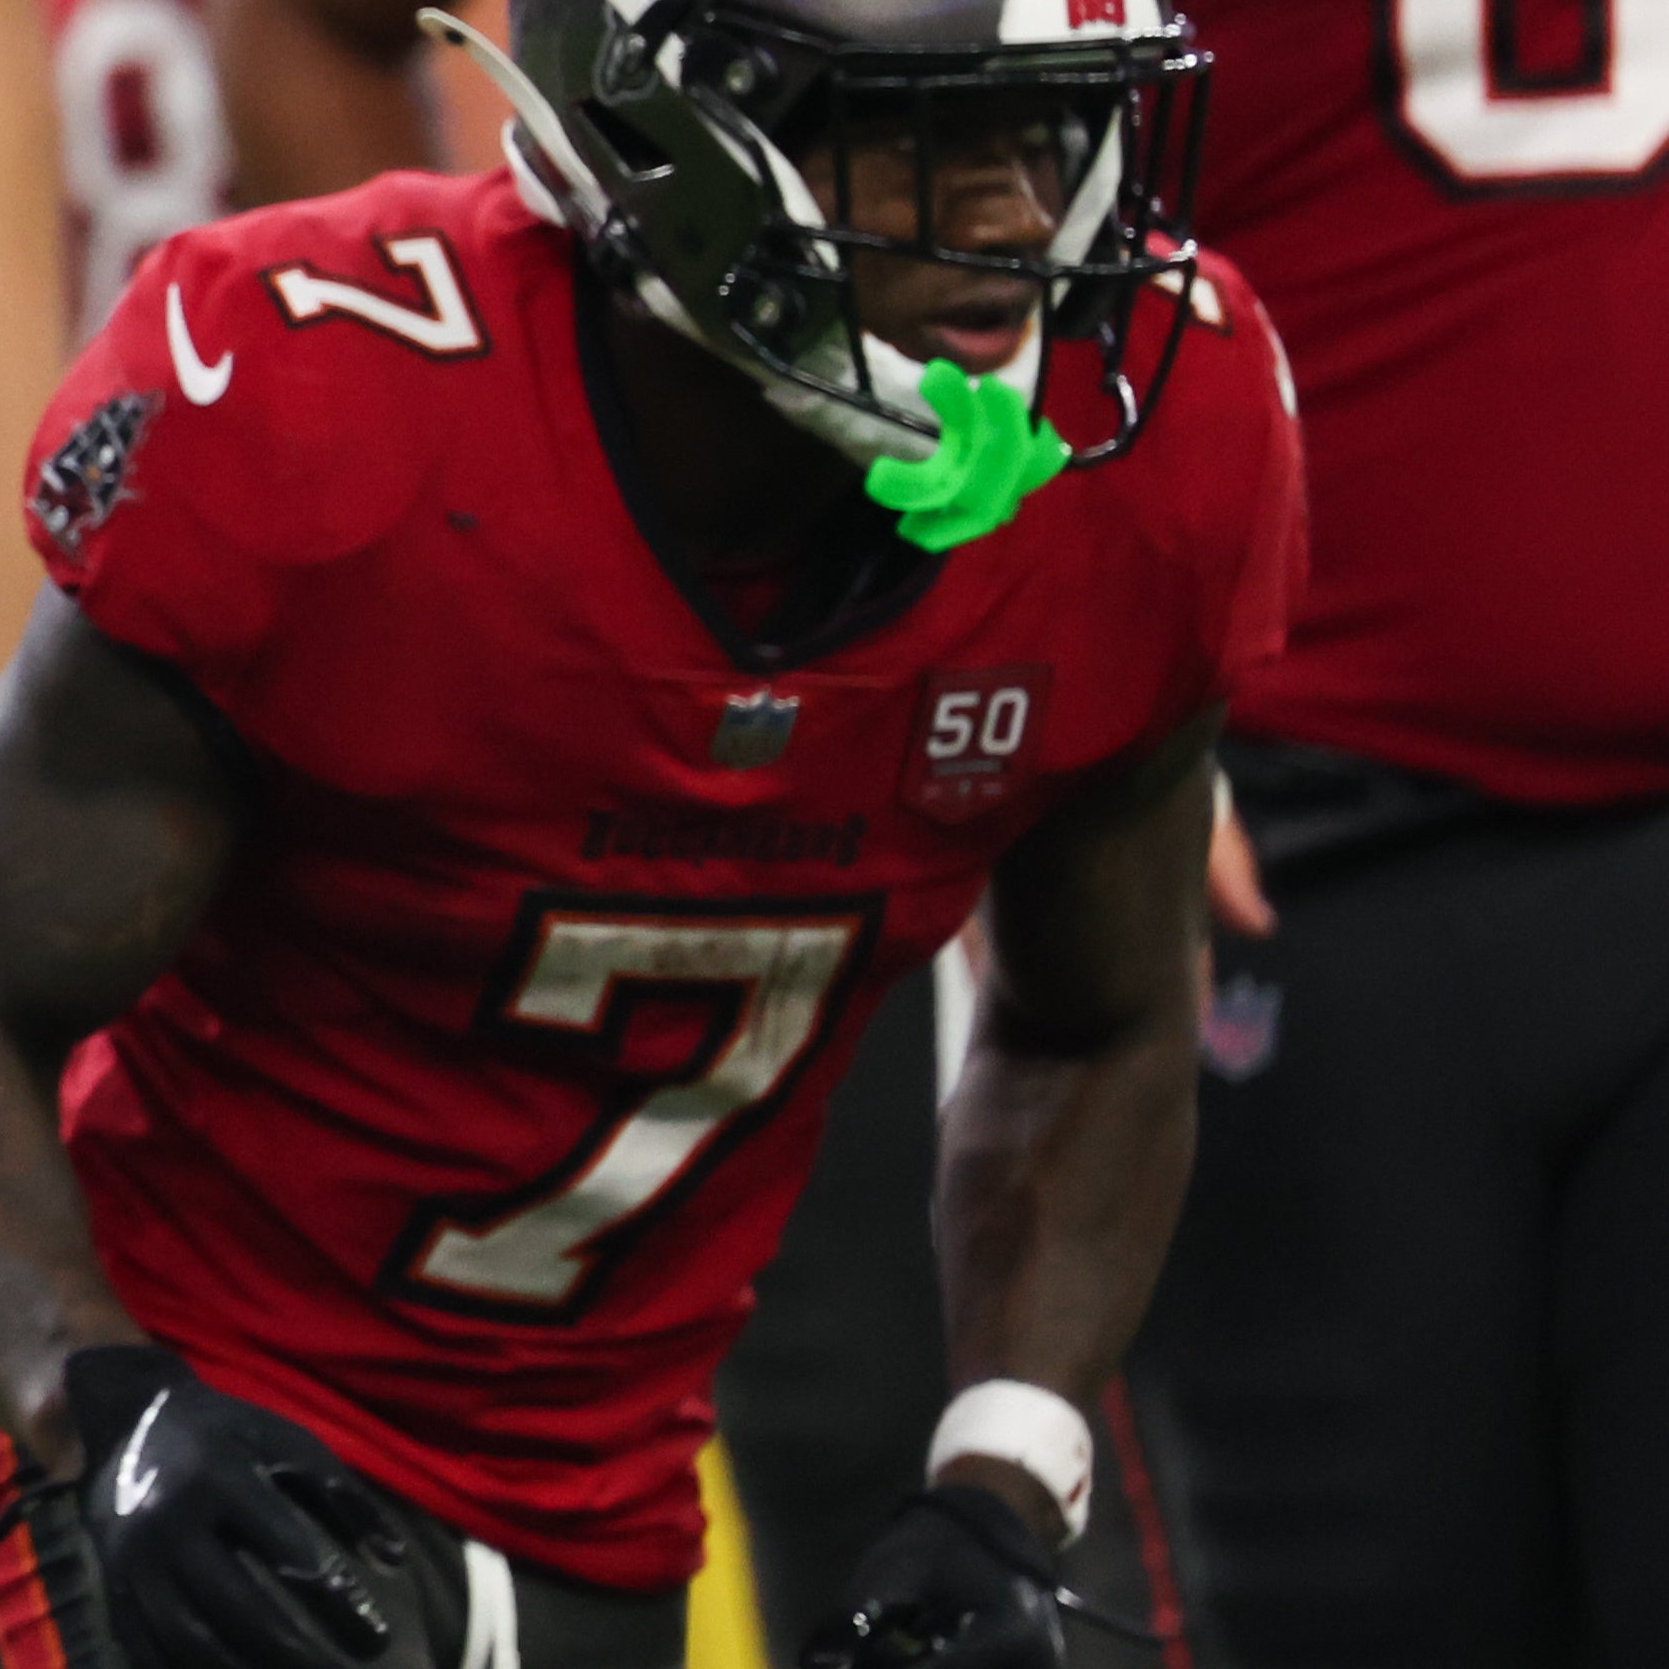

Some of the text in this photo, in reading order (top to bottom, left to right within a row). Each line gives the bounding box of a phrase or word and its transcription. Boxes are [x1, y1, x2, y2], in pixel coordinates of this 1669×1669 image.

[259, 228, 492, 362] 7
[925, 686, 1031, 759] 50
[385, 896, 879, 1320] 7
